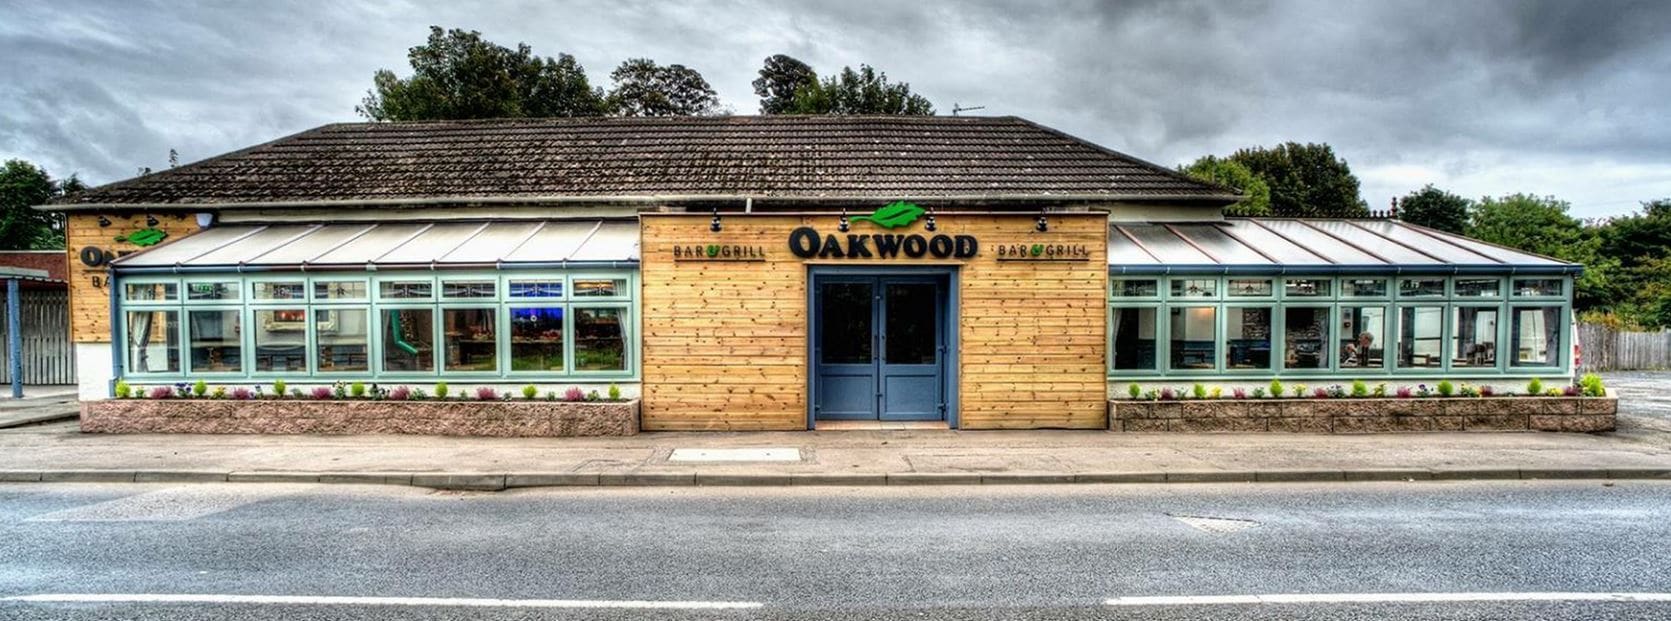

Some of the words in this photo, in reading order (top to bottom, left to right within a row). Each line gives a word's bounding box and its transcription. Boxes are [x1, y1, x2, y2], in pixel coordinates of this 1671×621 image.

[788, 227, 978, 258] OAKWOOD
[673, 245, 703, 257] BAR
[721, 245, 766, 257] GRILL
[998, 244, 1027, 257] BAR
[1046, 244, 1089, 257] GRILL
